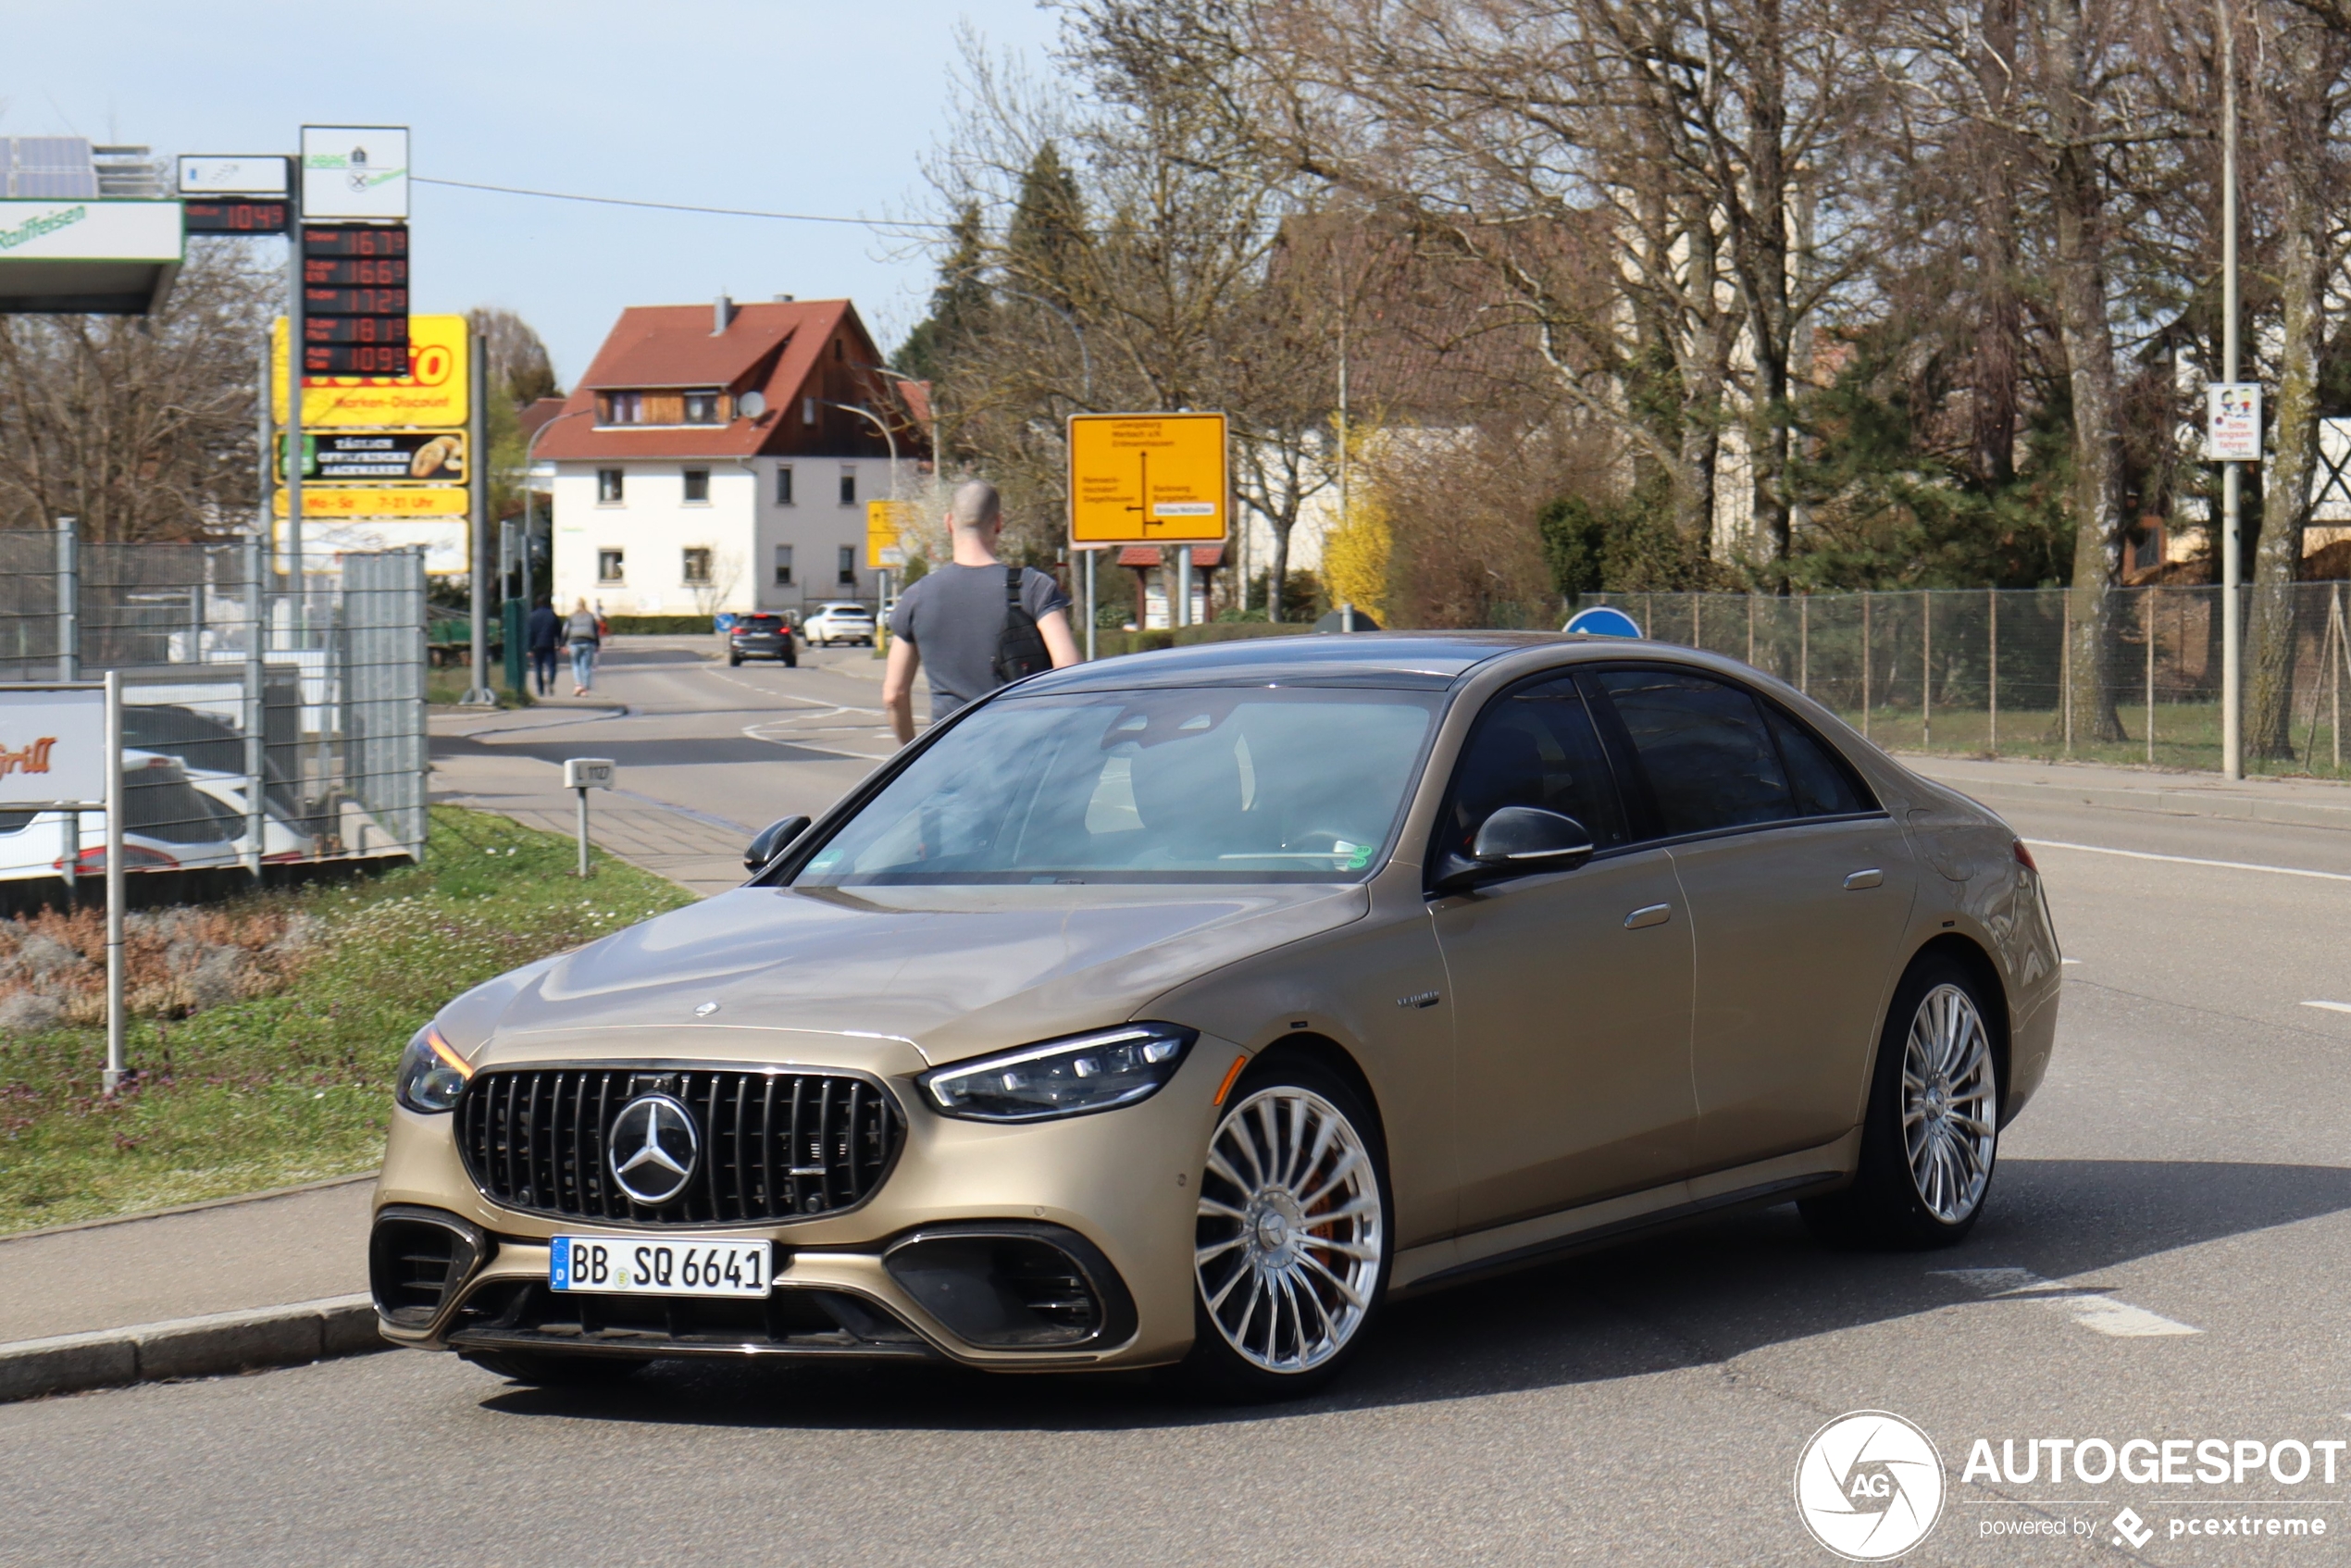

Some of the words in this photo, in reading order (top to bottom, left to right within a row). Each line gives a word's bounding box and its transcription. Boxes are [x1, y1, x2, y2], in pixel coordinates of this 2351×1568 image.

[2215, 430, 2254, 440] langsam
[572, 1244, 608, 1284] BB
[634, 1247, 673, 1287] SQ
[682, 1249, 764, 1289] 6641
[555, 1269, 565, 1280] D
